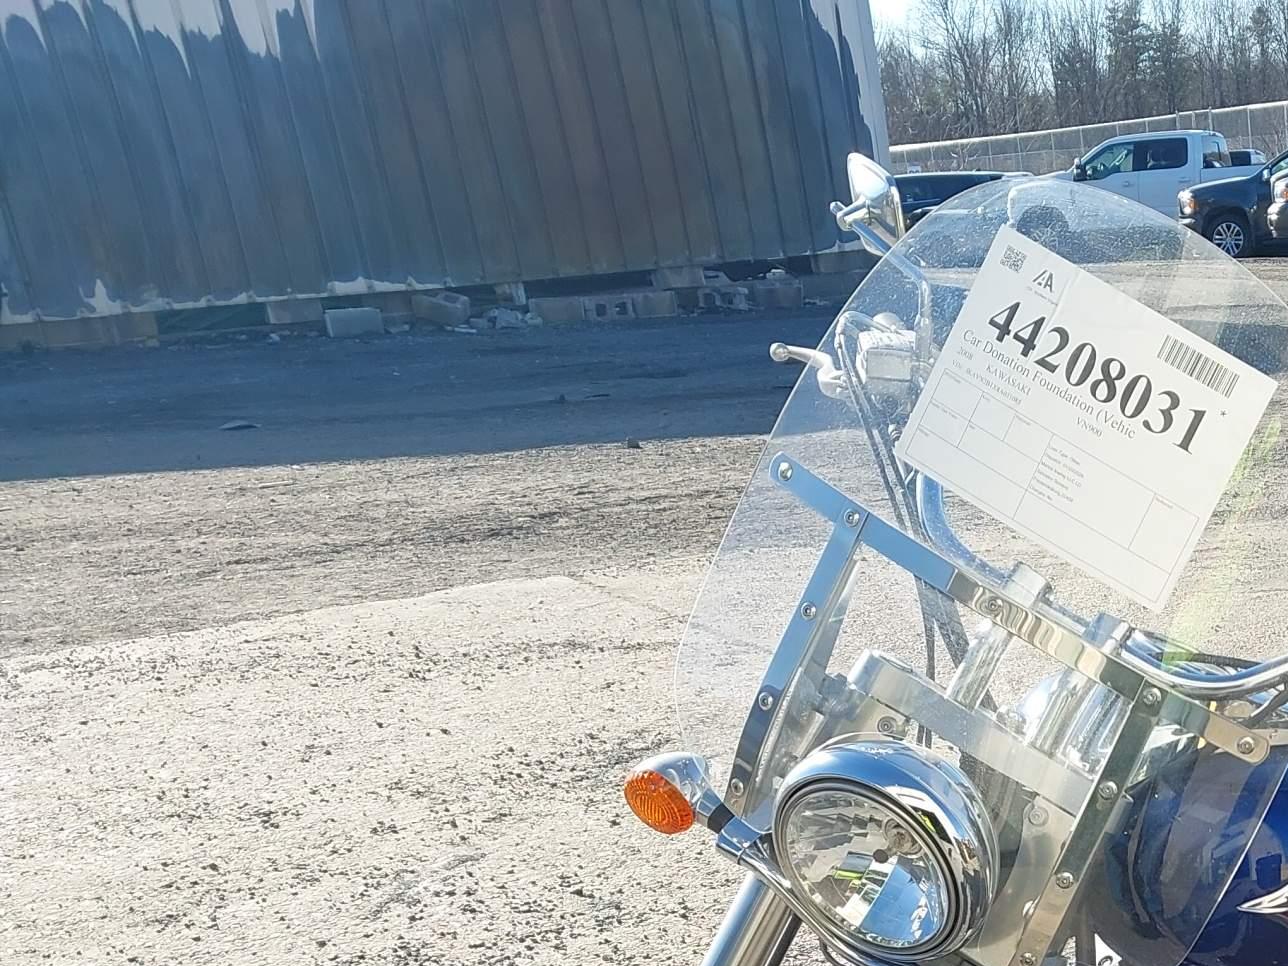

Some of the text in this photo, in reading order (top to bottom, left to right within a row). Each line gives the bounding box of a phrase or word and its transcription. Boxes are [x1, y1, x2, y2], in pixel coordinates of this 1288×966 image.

[963, 329, 983, 348] Car
[983, 341, 1030, 378] Donation
[1032, 370, 1095, 416] Foundation
[1095, 408, 1137, 440] (Vehic
[985, 363, 1031, 396] KAWASAKI
[988, 302, 1207, 455] 44208031
